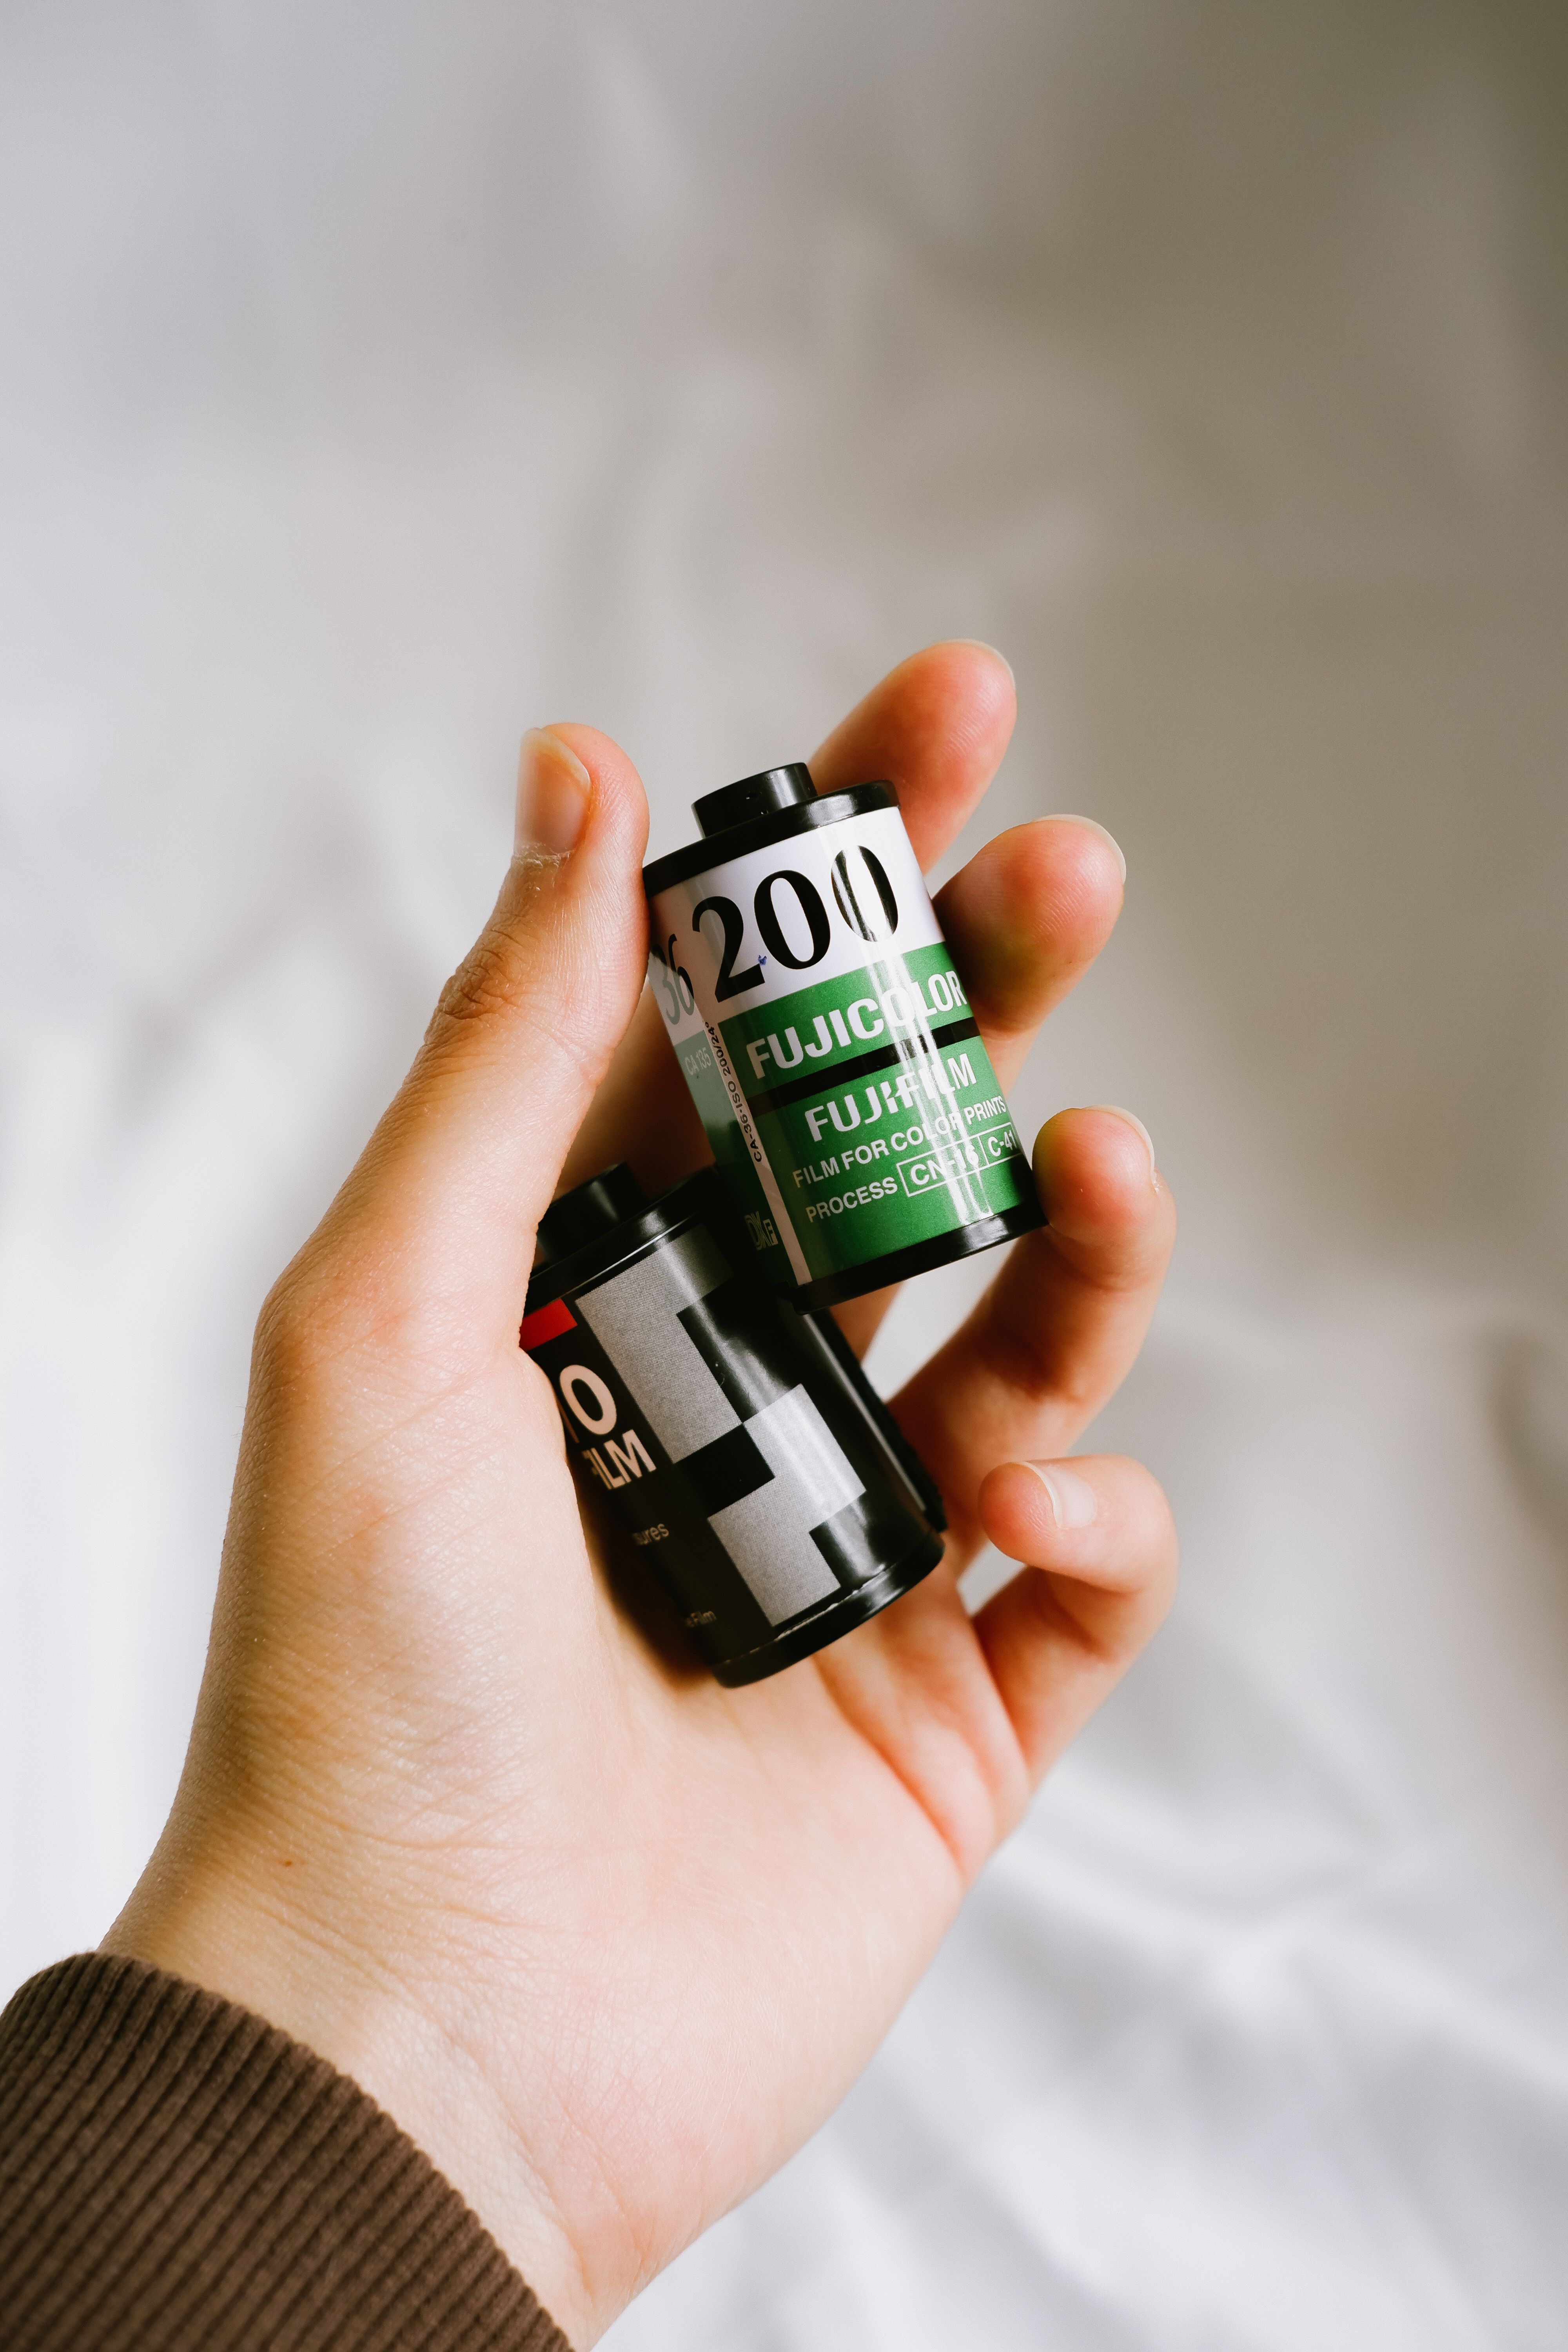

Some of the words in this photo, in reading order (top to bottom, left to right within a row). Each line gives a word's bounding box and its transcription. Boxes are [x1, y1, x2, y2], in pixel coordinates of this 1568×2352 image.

[692, 845, 898, 1003] 200
[652, 933, 695, 1025] 36
[746, 970, 968, 1079] FUJICOLOR
[685, 1054, 699, 1076] CA
[696, 1047, 712, 1070] 135
[804, 1053, 976, 1142] FUJIFILM
[793, 1157, 840, 1188] FILM
[841, 1139, 889, 1170] FOR
[891, 1112, 964, 1151] COLOR
[964, 1095, 1007, 1126] PRINTS
[806, 1176, 898, 1223] PROCESS
[909, 1144, 979, 1185] CN-16
[987, 1130, 1016, 1157] C-41
[554, 1364, 617, 1444] O
